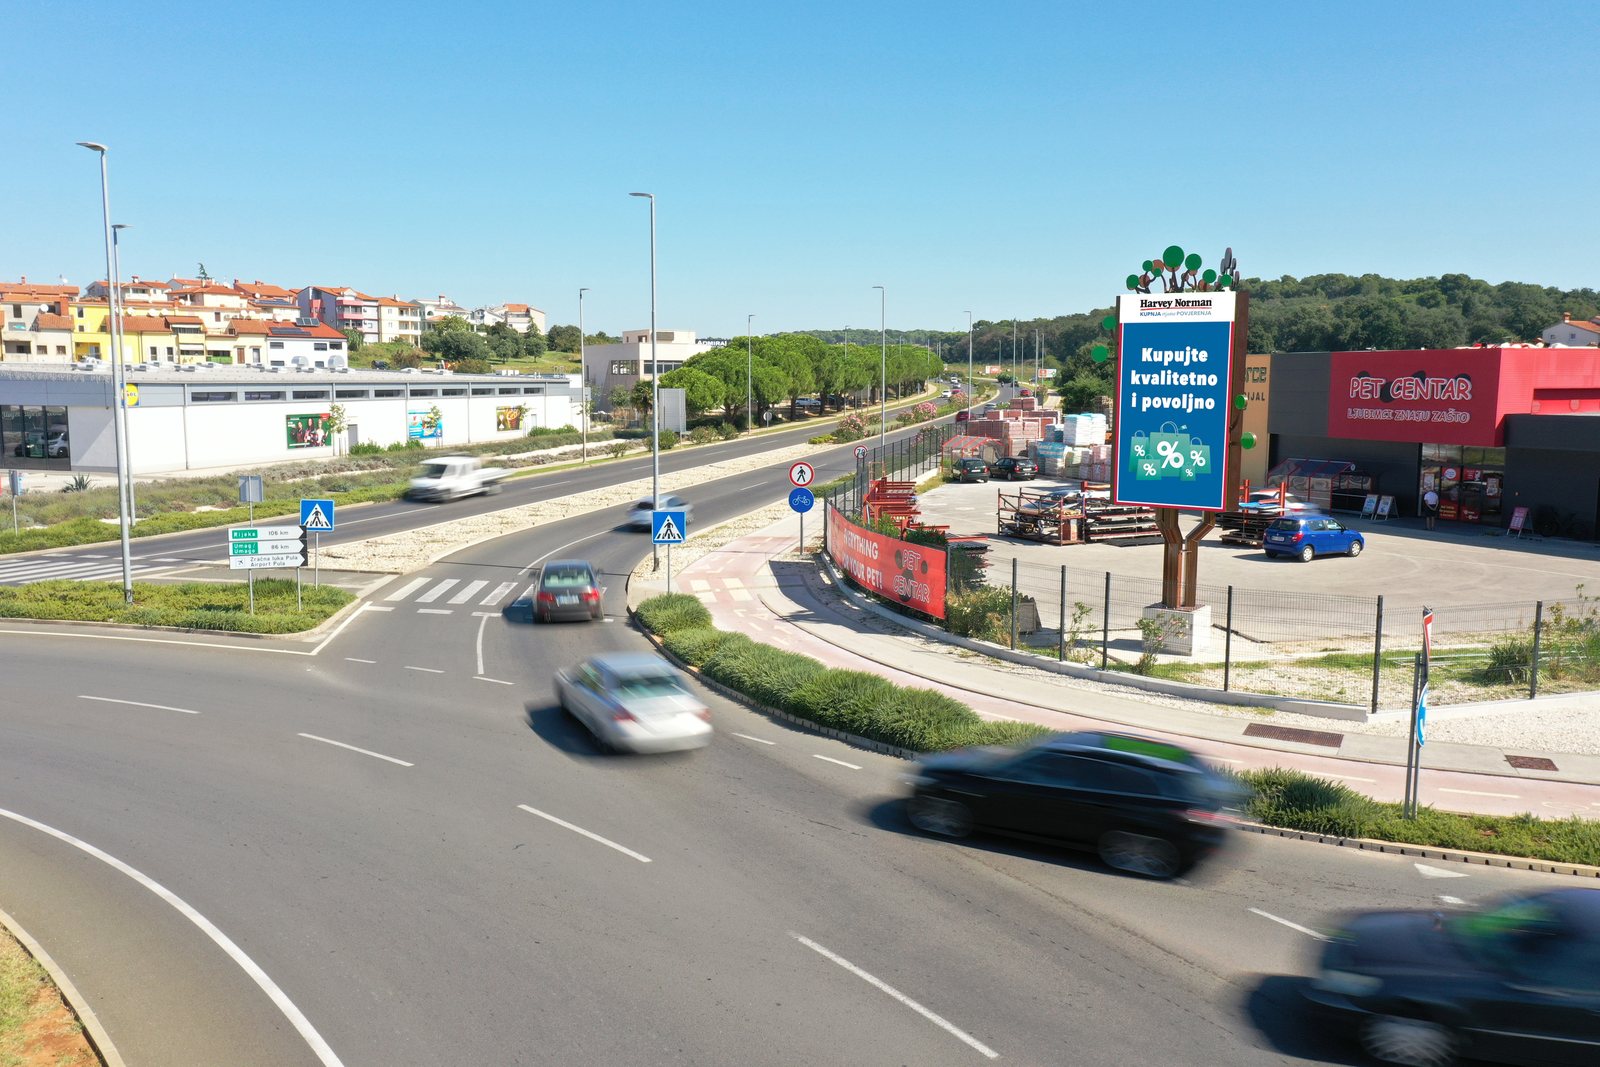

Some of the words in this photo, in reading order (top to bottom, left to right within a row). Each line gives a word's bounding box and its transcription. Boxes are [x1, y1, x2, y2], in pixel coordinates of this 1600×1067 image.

[1140, 299, 1173, 310] Harvey
[1175, 298, 1212, 307] Norman
[1141, 346, 1208, 366] Kupujte
[1130, 369, 1218, 386] kvalitetno
[1350, 377, 1384, 399] PET
[1389, 376, 1472, 400] CENTAR
[1131, 392, 1137, 408] i
[1141, 393, 1215, 413] povoljno
[902, 549, 921, 571] PET
[849, 555, 866, 582] YOUR
[866, 566, 883, 590] PET!
[893, 575, 930, 604] CENTAR
